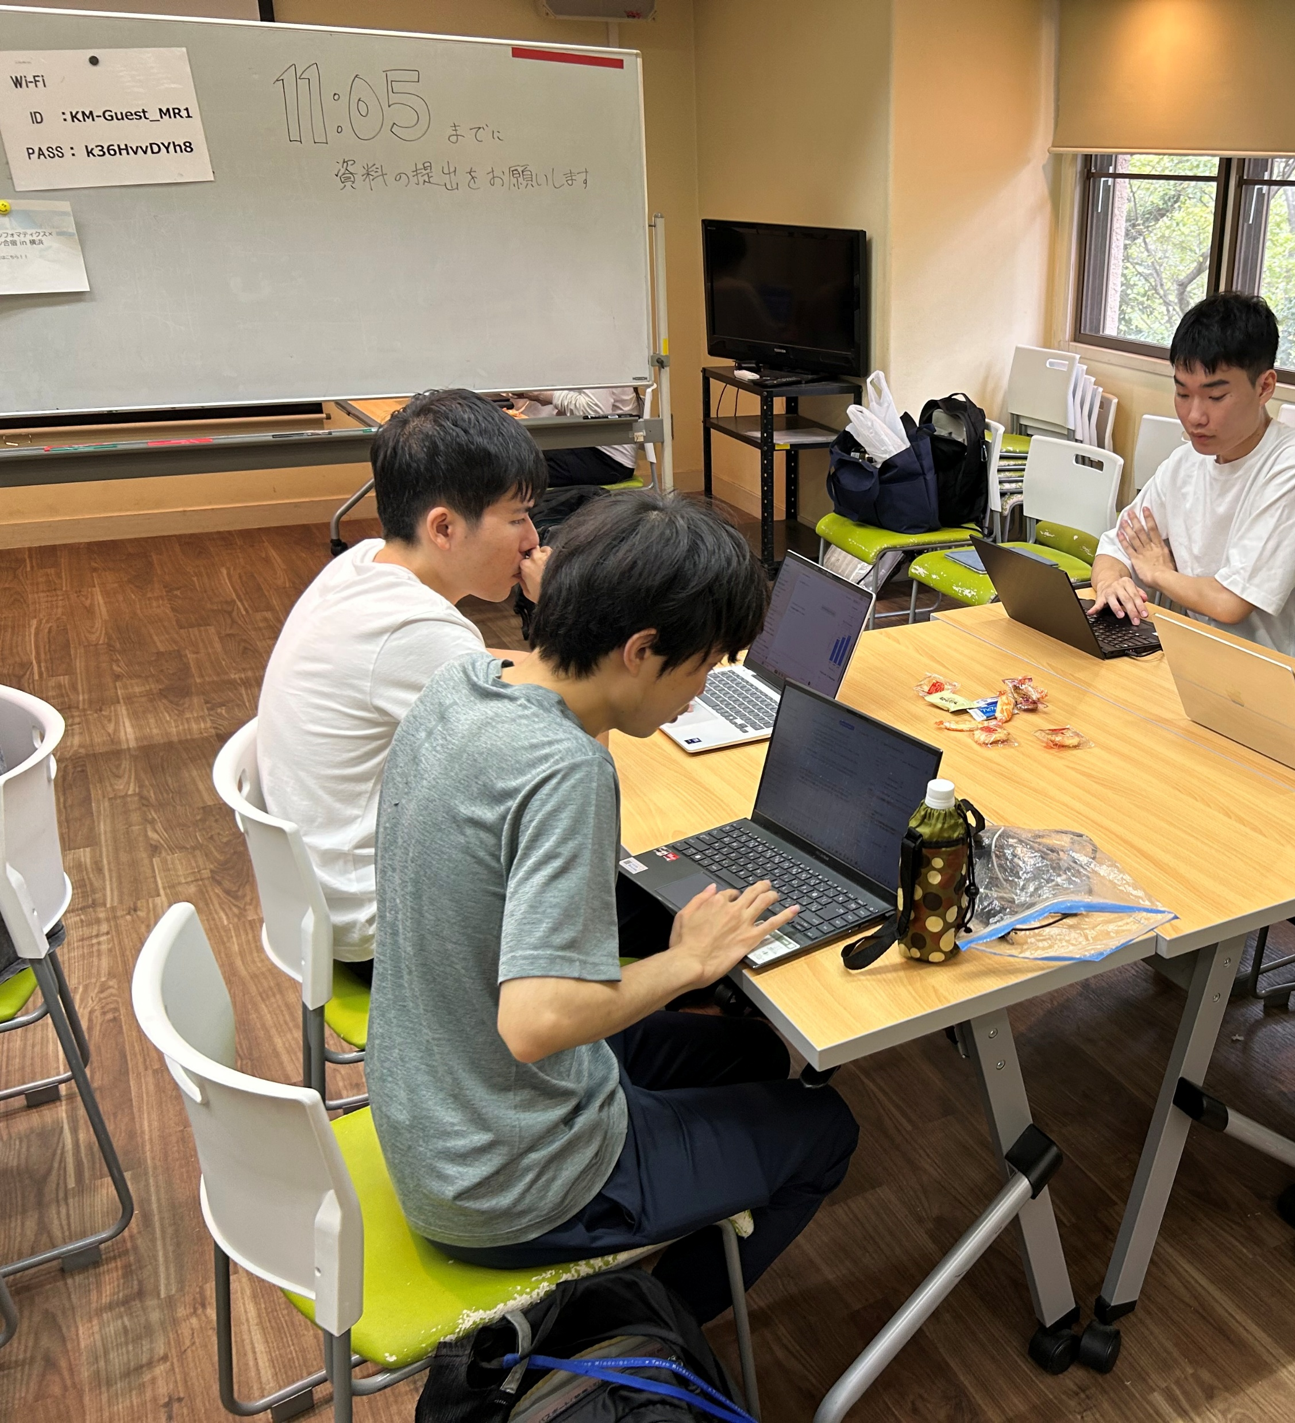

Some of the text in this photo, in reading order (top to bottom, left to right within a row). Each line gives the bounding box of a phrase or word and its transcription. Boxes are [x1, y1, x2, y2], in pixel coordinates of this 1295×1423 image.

[10, 75, 47, 89] Wi-Fi
[273, 62, 504, 145] 11:05 までに
[29, 111, 44, 124] ID
[84, 140, 194, 158] k36HvvDYh8
[334, 158, 589, 191] 資料の提出をお願いします
